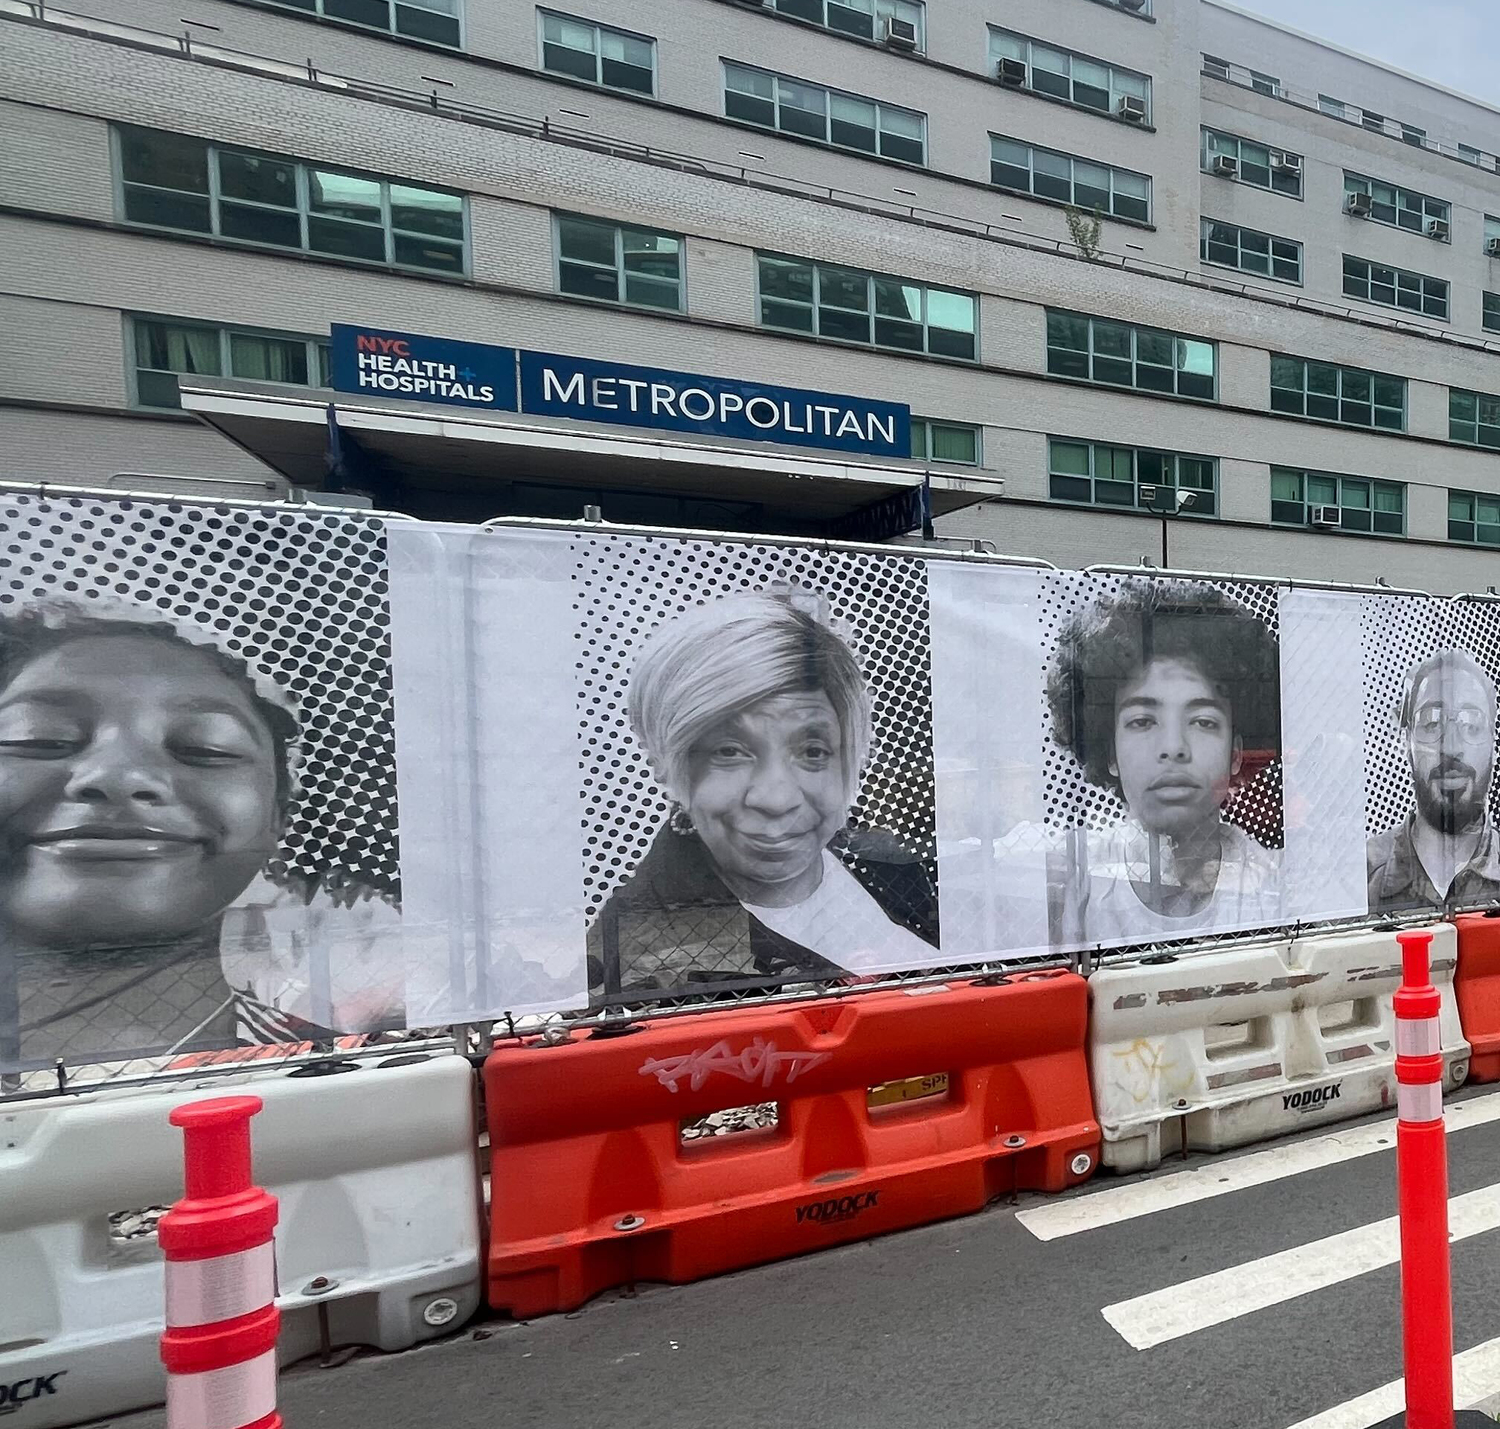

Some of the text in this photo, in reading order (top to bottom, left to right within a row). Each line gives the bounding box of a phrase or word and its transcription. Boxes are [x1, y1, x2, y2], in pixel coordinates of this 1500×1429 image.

[357, 335, 411, 356] NYC
[358, 353, 456, 380] HEALTH
[359, 371, 494, 401] HOSPITALS
[543, 368, 894, 444] METROPOLITAN
[1282, 1083, 1342, 1110] YODOCK
[795, 1190, 880, 1224] YODOCK
